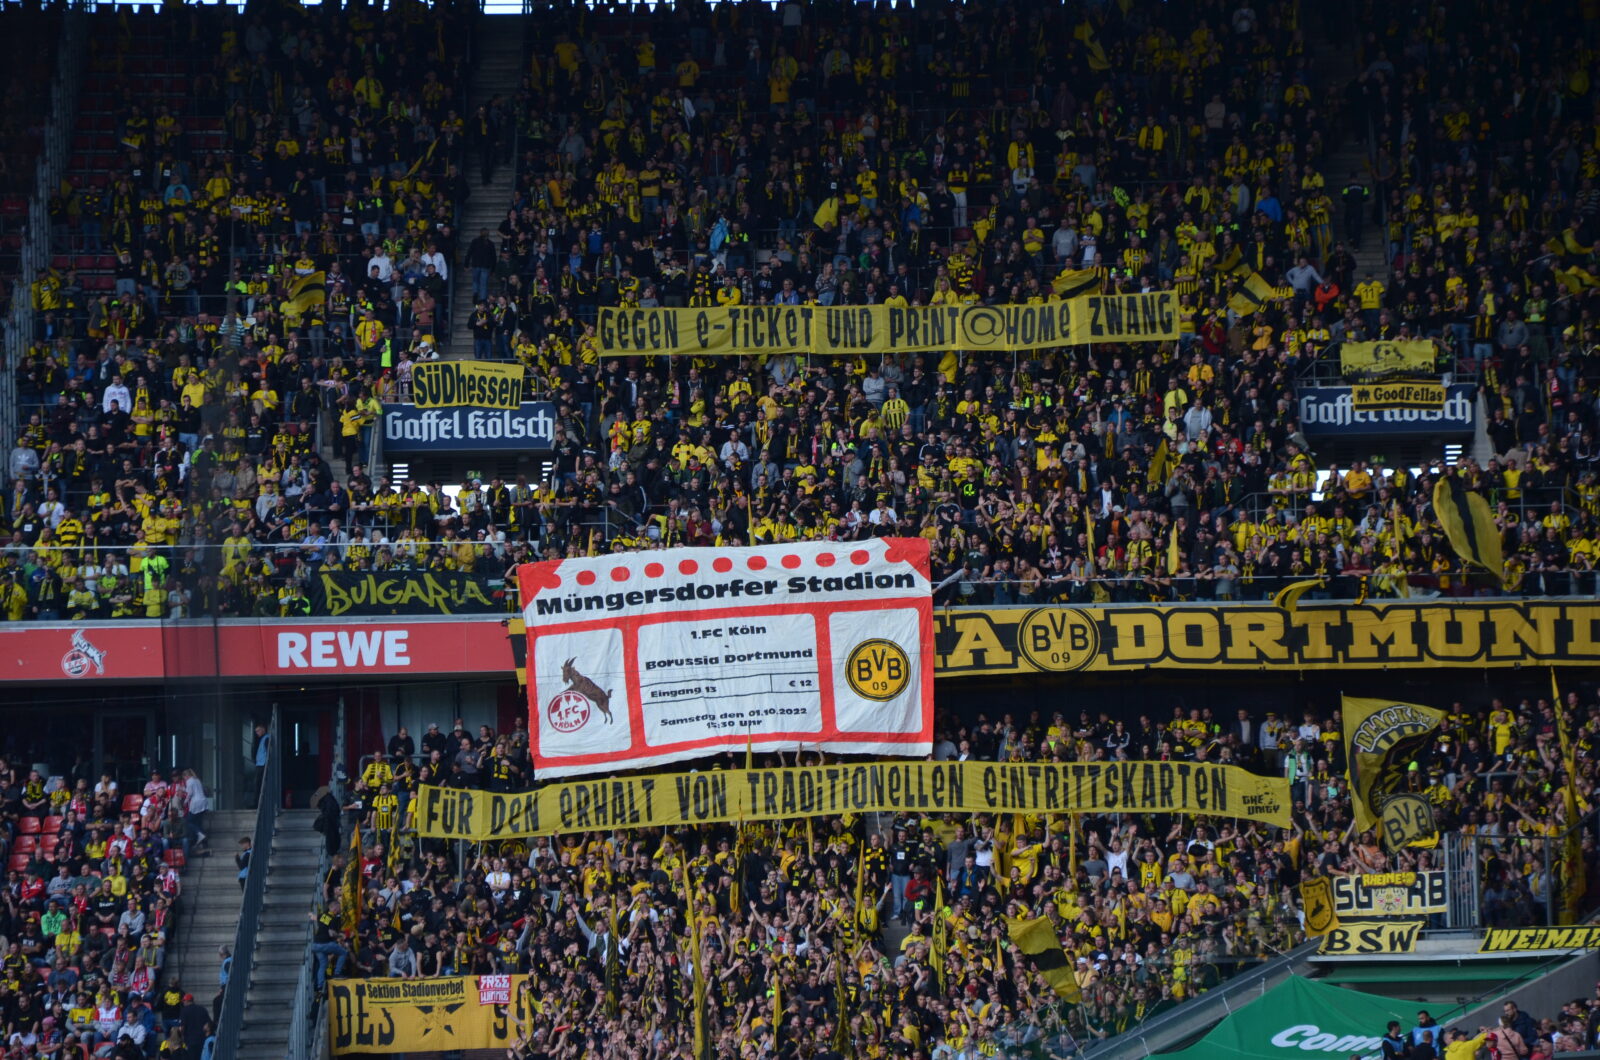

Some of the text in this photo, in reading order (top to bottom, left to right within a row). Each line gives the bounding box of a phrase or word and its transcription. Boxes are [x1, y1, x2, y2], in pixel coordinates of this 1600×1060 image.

[826, 308, 873, 348] UND
[1089, 293, 1174, 336] ZWANG
[1374, 386, 1443, 402] GoodFellas
[385, 409, 554, 442] Gaffel Kölsch
[536, 571, 915, 616] Müngersdorfer Stadion
[690, 625, 767, 640] 1.FC Köln
[1031, 612, 1090, 652] BVB
[278, 630, 411, 668] REWE
[645, 648, 813, 671] Borussia Dortmund
[1051, 651, 1071, 664] 09
[857, 648, 902, 682] BVB
[650, 685, 717, 698] Eingang 13
[799, 679, 812, 687] 12
[872, 681, 888, 691] 09
[660, 707, 807, 727] Samstag den 01.10.2022
[425, 788, 475, 835] FÜR
[675, 773, 728, 821] VON
[1325, 922, 1420, 953] BSW
[367, 984, 400, 999] Sektion
[480, 975, 510, 990] FREE
